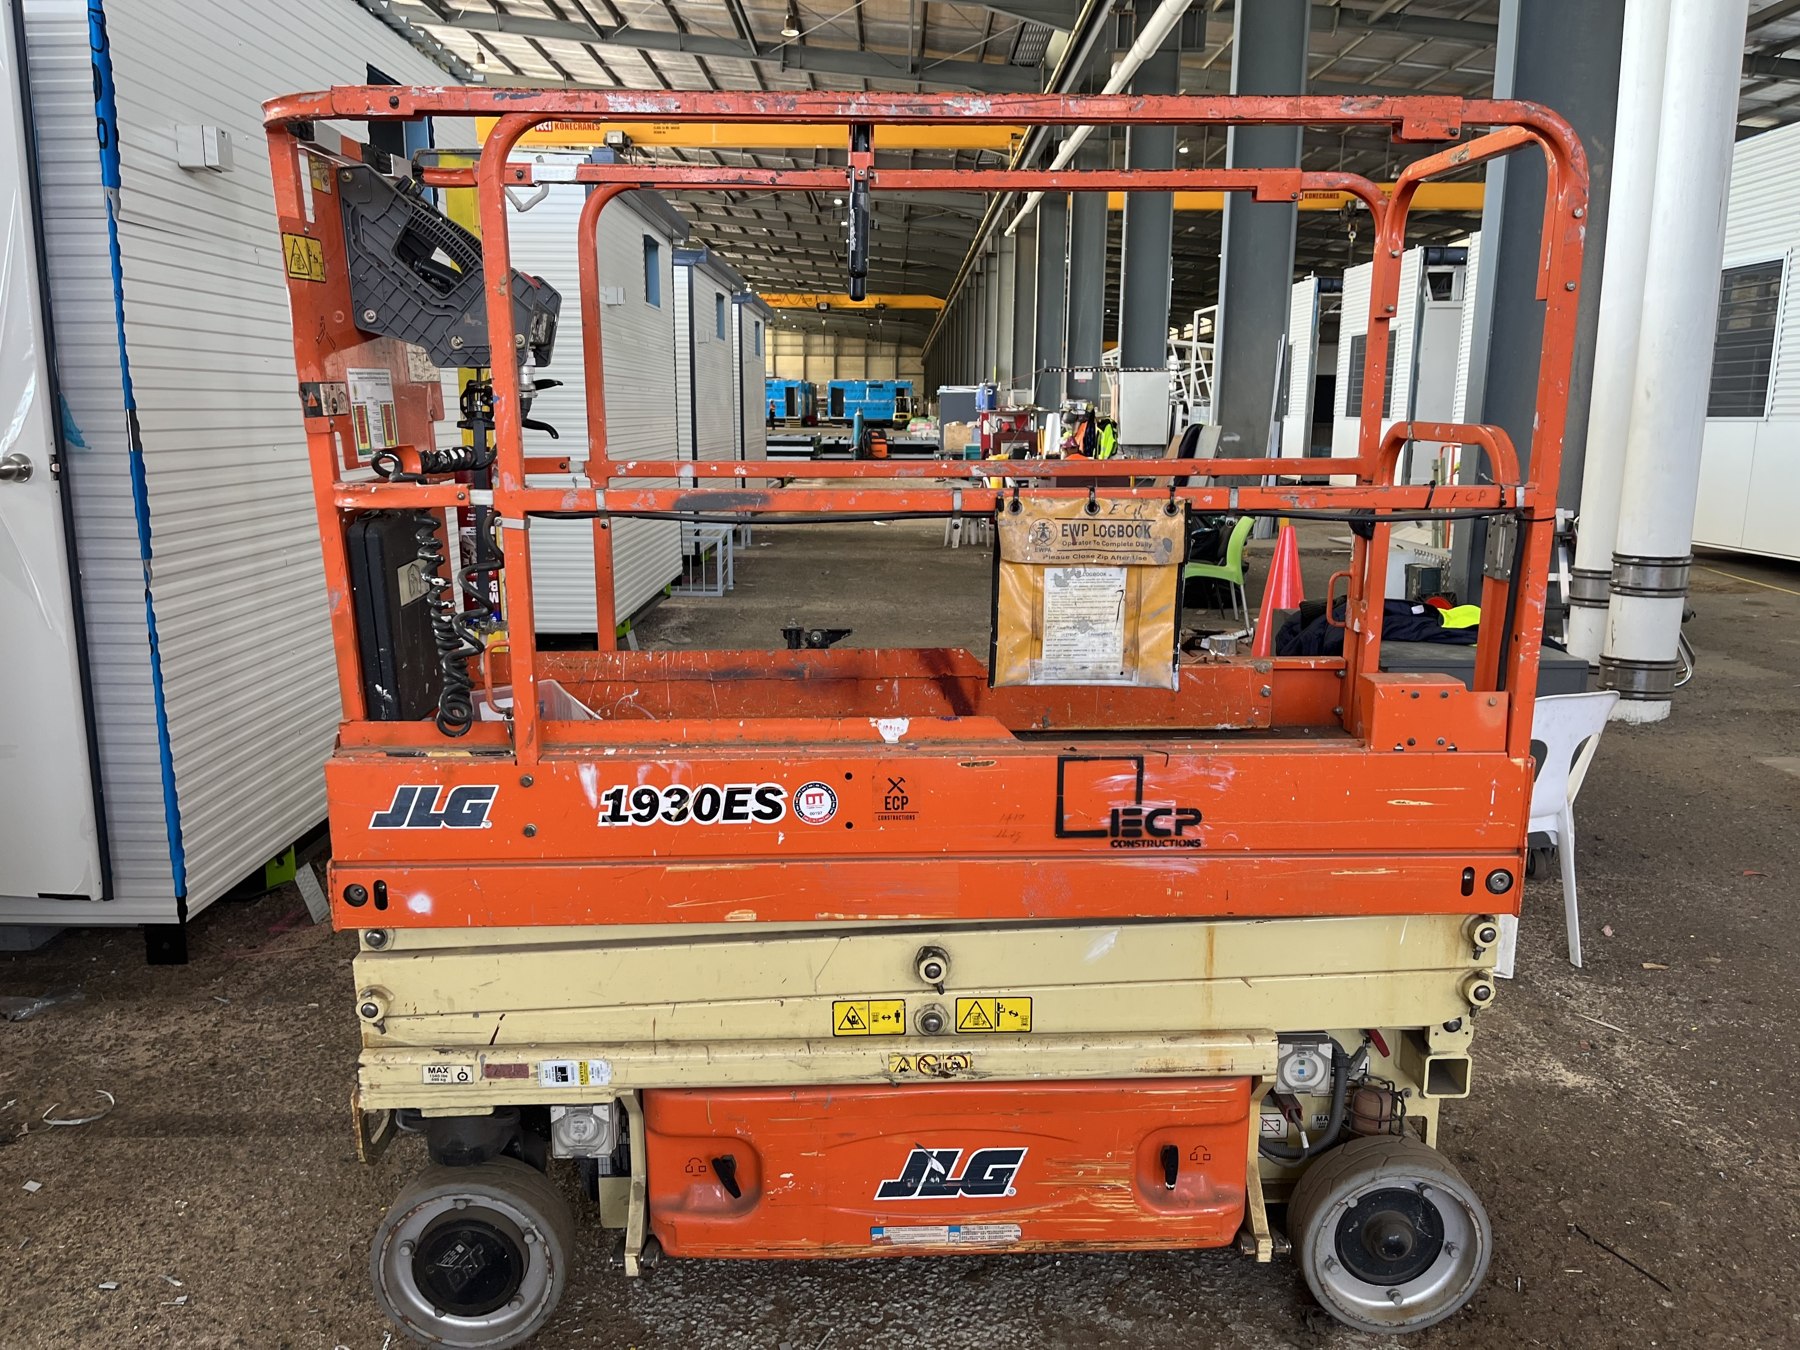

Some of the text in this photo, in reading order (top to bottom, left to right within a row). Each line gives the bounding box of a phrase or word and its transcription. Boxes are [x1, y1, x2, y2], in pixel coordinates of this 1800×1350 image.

[554, 121, 601, 131] KONECRANES
[1304, 192, 1340, 200] KONECRANES
[1061, 523, 1152, 538] EWP LOGBOOK
[369, 785, 497, 829] JLG
[599, 783, 787, 826] 1930ES
[884, 796, 909, 810] ECP
[1110, 839, 1201, 848] CONSTRUCTIONS
[427, 1066, 449, 1074] MAX
[875, 1148, 1028, 1199] JLG
